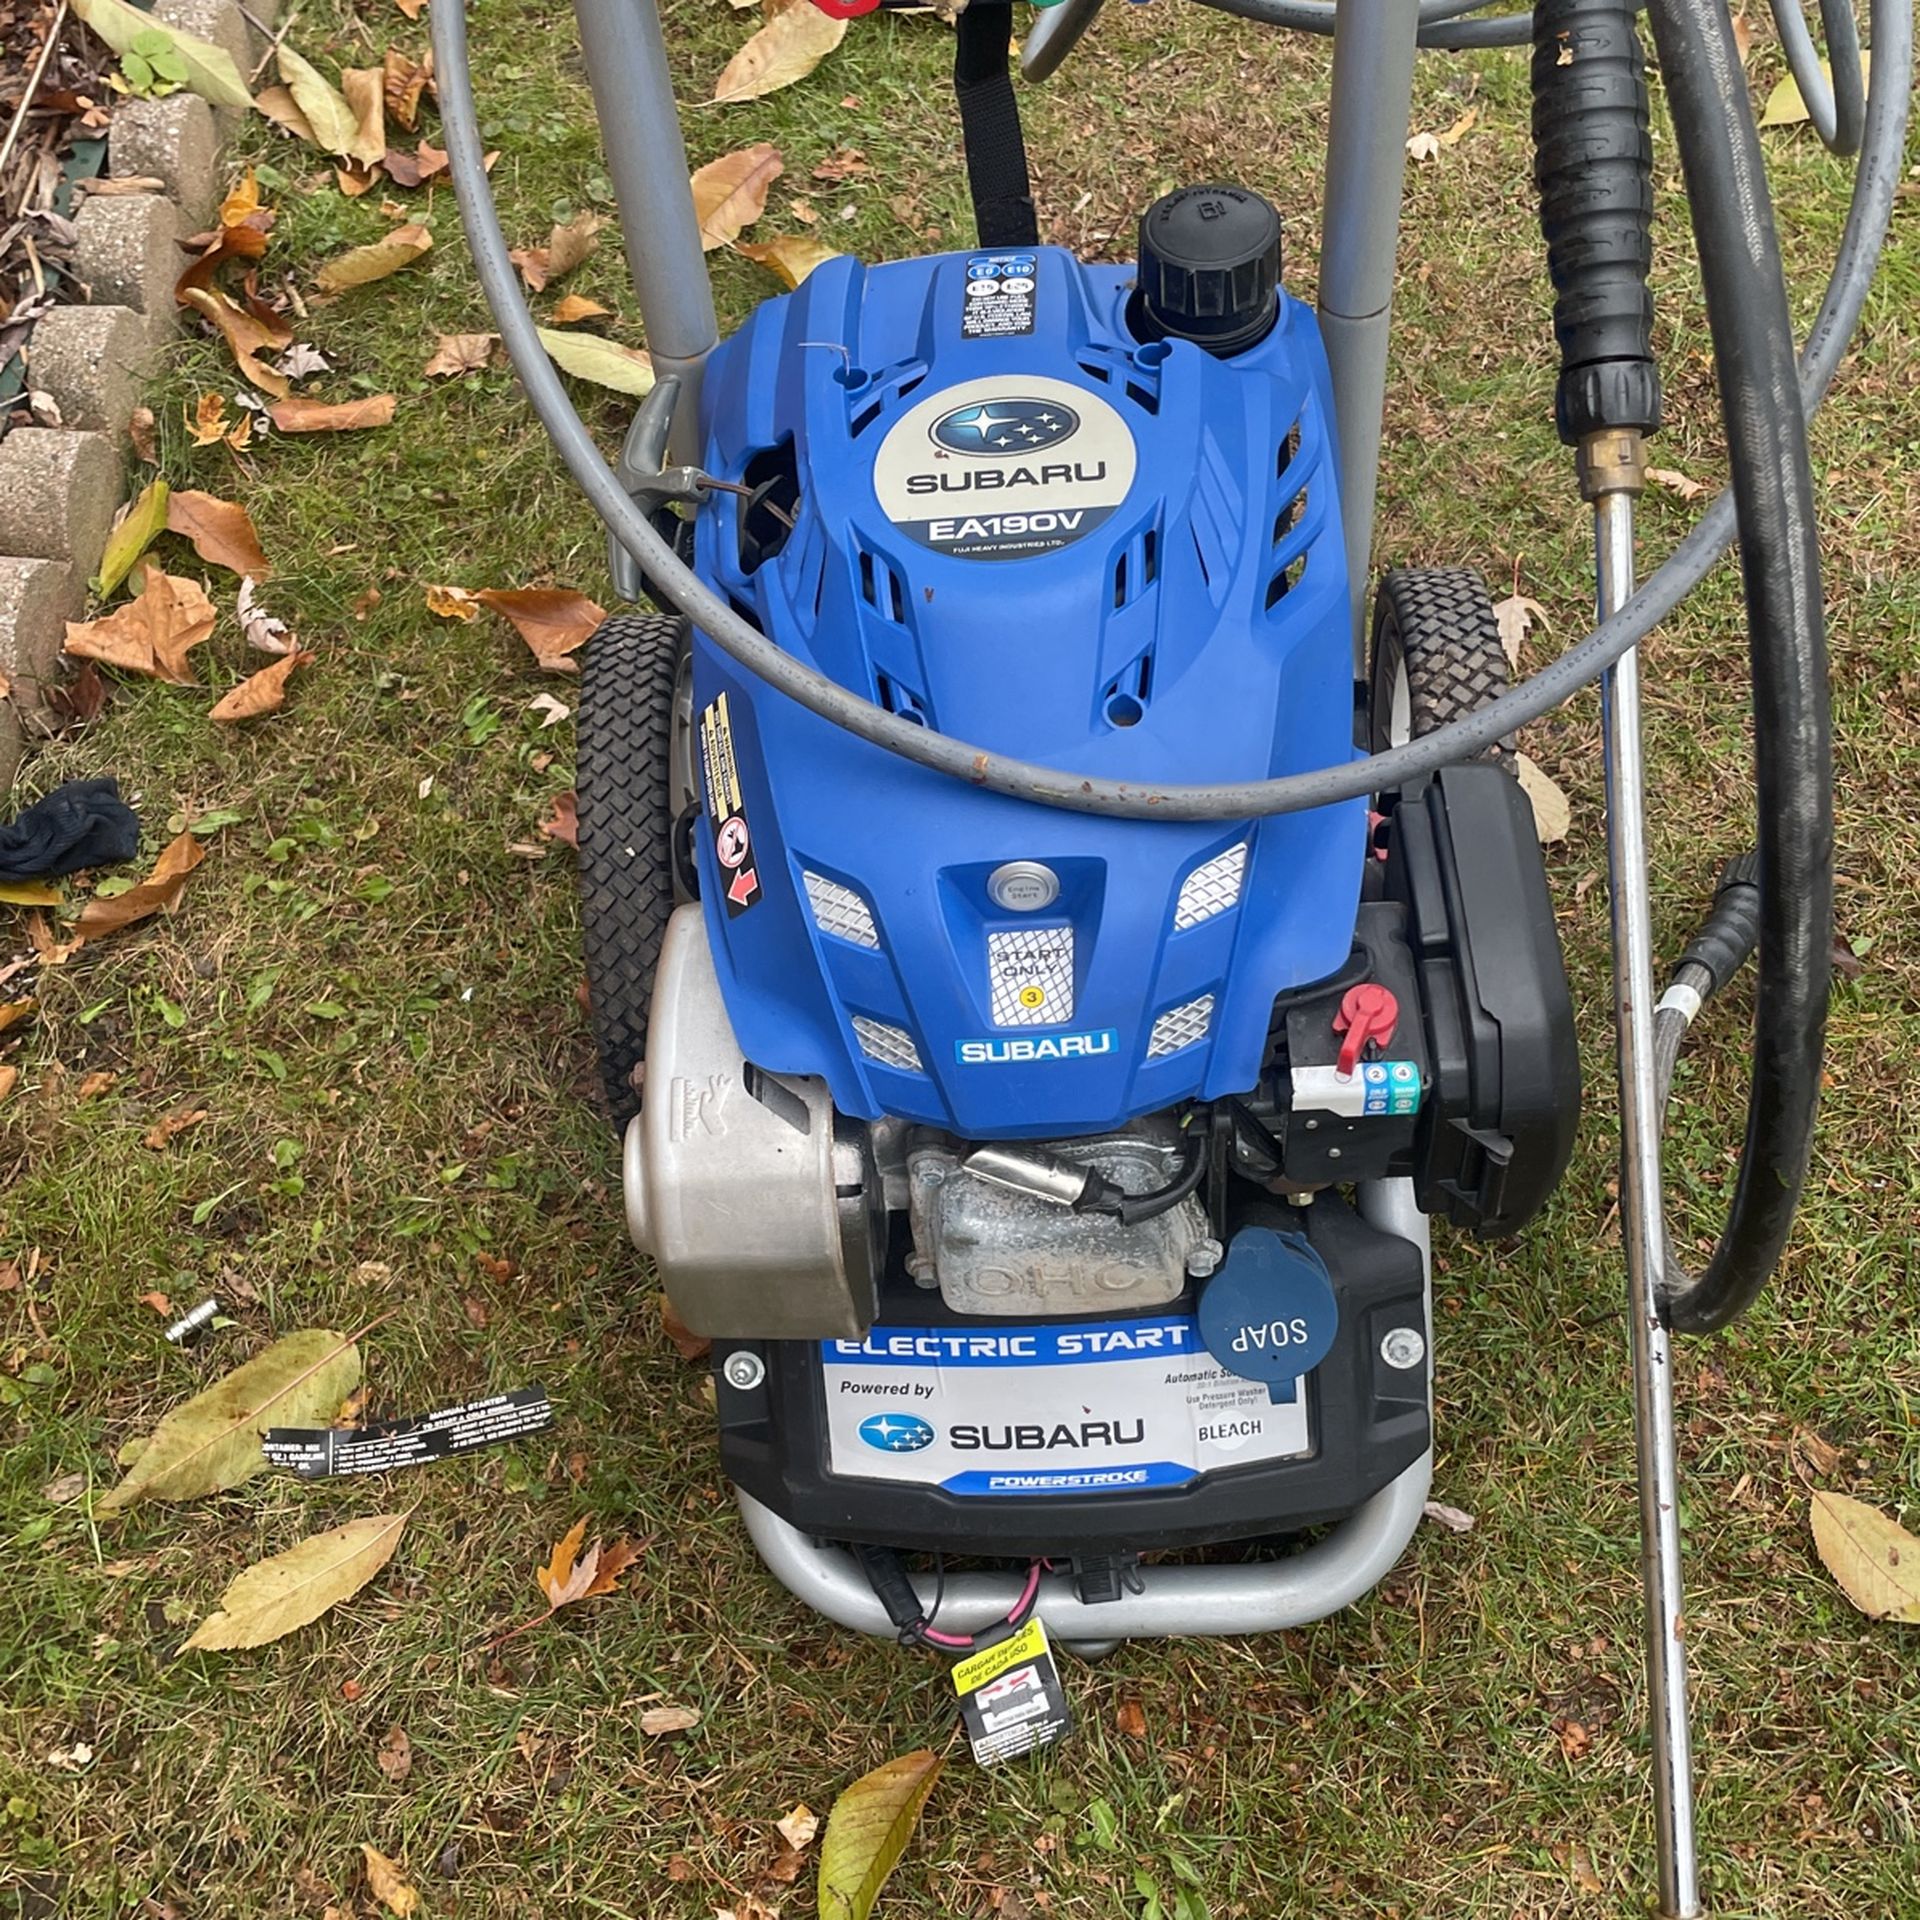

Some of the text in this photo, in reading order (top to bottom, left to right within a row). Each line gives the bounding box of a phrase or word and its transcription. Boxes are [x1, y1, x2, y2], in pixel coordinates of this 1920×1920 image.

[1007, 265, 1030, 274] E10
[906, 461, 1106, 494] SUBARU
[929, 511, 1084, 541] EA190V
[999, 541, 1044, 550] INDUSTRIES
[996, 947, 1064, 963] START
[1003, 964, 1058, 977] ONLY
[1027, 991, 1038, 1003] 3
[961, 1033, 1111, 1063] SUBARU
[1372, 1070, 1381, 1078] 2
[836, 1325, 1189, 1357] ELECTRIC START
[1231, 1318, 1308, 1352] SOAP
[1165, 1369, 1218, 1384] Automatic
[840, 1381, 934, 1399] Powered by
[1186, 1386, 1266, 1404] Use Pressure Washer
[1199, 1399, 1236, 1410] Detergent
[949, 1418, 1145, 1450] SUBARU
[1198, 1419, 1262, 1442] BLEACH
[989, 1469, 1148, 1490] POWERSTROKE
